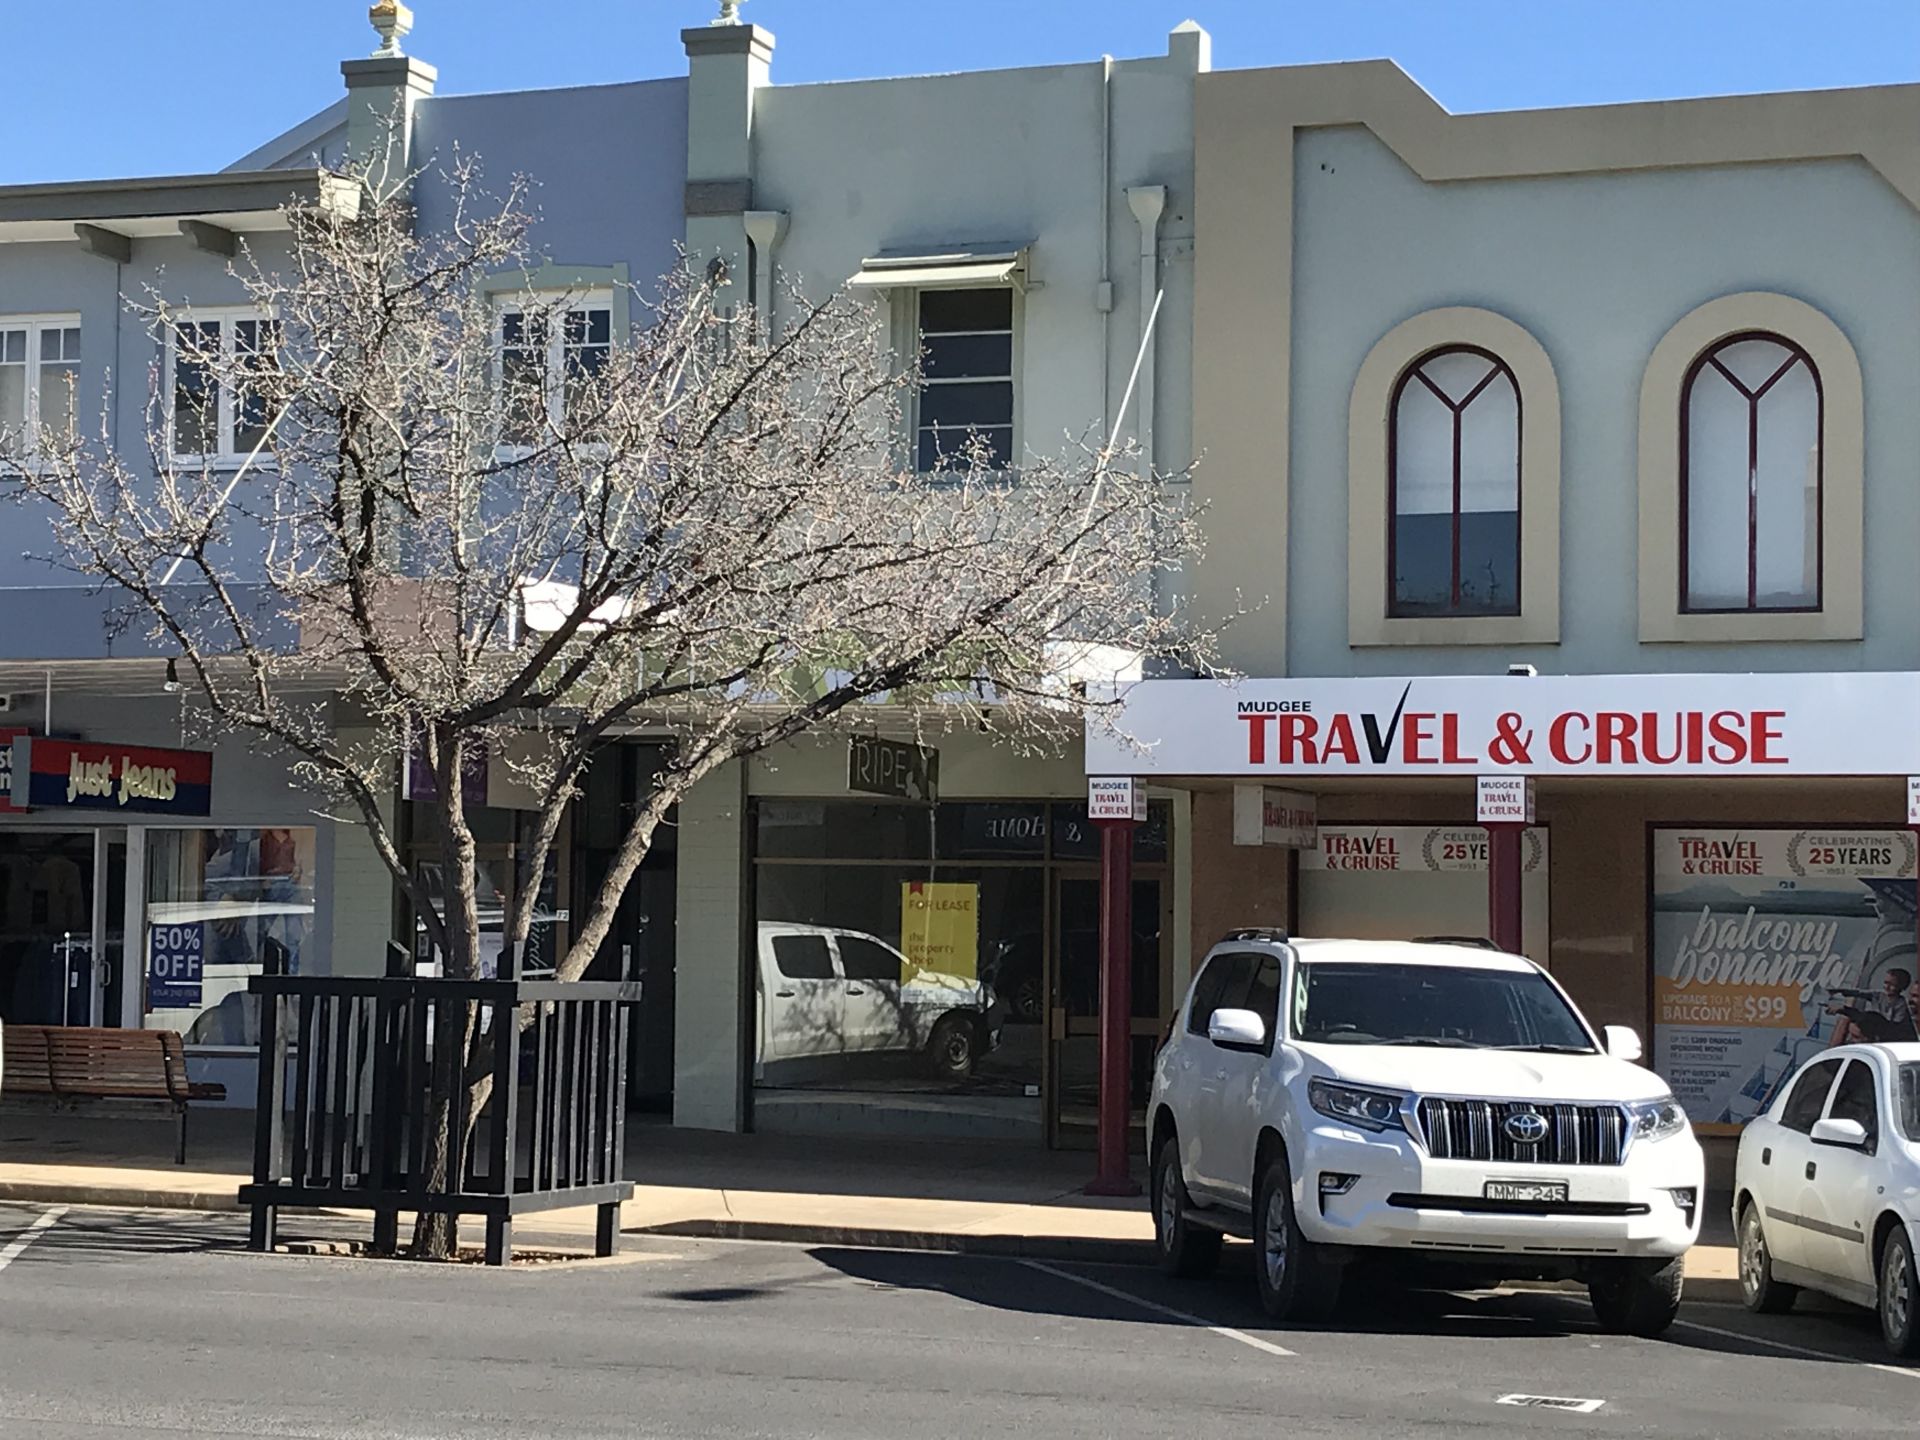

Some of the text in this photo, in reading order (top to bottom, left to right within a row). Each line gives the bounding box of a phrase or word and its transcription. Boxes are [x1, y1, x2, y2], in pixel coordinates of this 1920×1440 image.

[1238, 702, 1311, 713] MUDGEE
[1238, 681, 1789, 765] TRAVEL & CRUISE
[856, 743, 906, 789] RIPE
[1091, 782, 1129, 790] MUDGEE
[1480, 781, 1521, 789] MUDGEE
[1095, 791, 1126, 803] TRAVEL
[1484, 790, 1517, 803] TRAVEL
[1099, 806, 1129, 815] CRUISE
[1479, 806, 1523, 815] & CRUISE
[1323, 829, 1400, 855] TRAVEL
[1443, 833, 1489, 842] CELEBR
[1809, 837, 1892, 845] CELEBRATING
[1443, 844, 1467, 859] 25
[1678, 832, 1763, 859] TRAVEL
[1326, 855, 1400, 870] & CRUISE
[1809, 848, 1892, 865] 25 YEARS
[1683, 859, 1763, 875] & CRUISE
[909, 900, 971, 911] FOR LEASE
[155, 927, 200, 950] 50%
[1693, 905, 1838, 962] balcony
[909, 944, 955, 955] property
[155, 954, 200, 977] OFF
[1671, 935, 1848, 1003] bonanza
[1662, 994, 1708, 1005] UPGRADE
[1662, 1005, 1732, 1021] BALCONY
[1744, 994, 1787, 1022] $99
